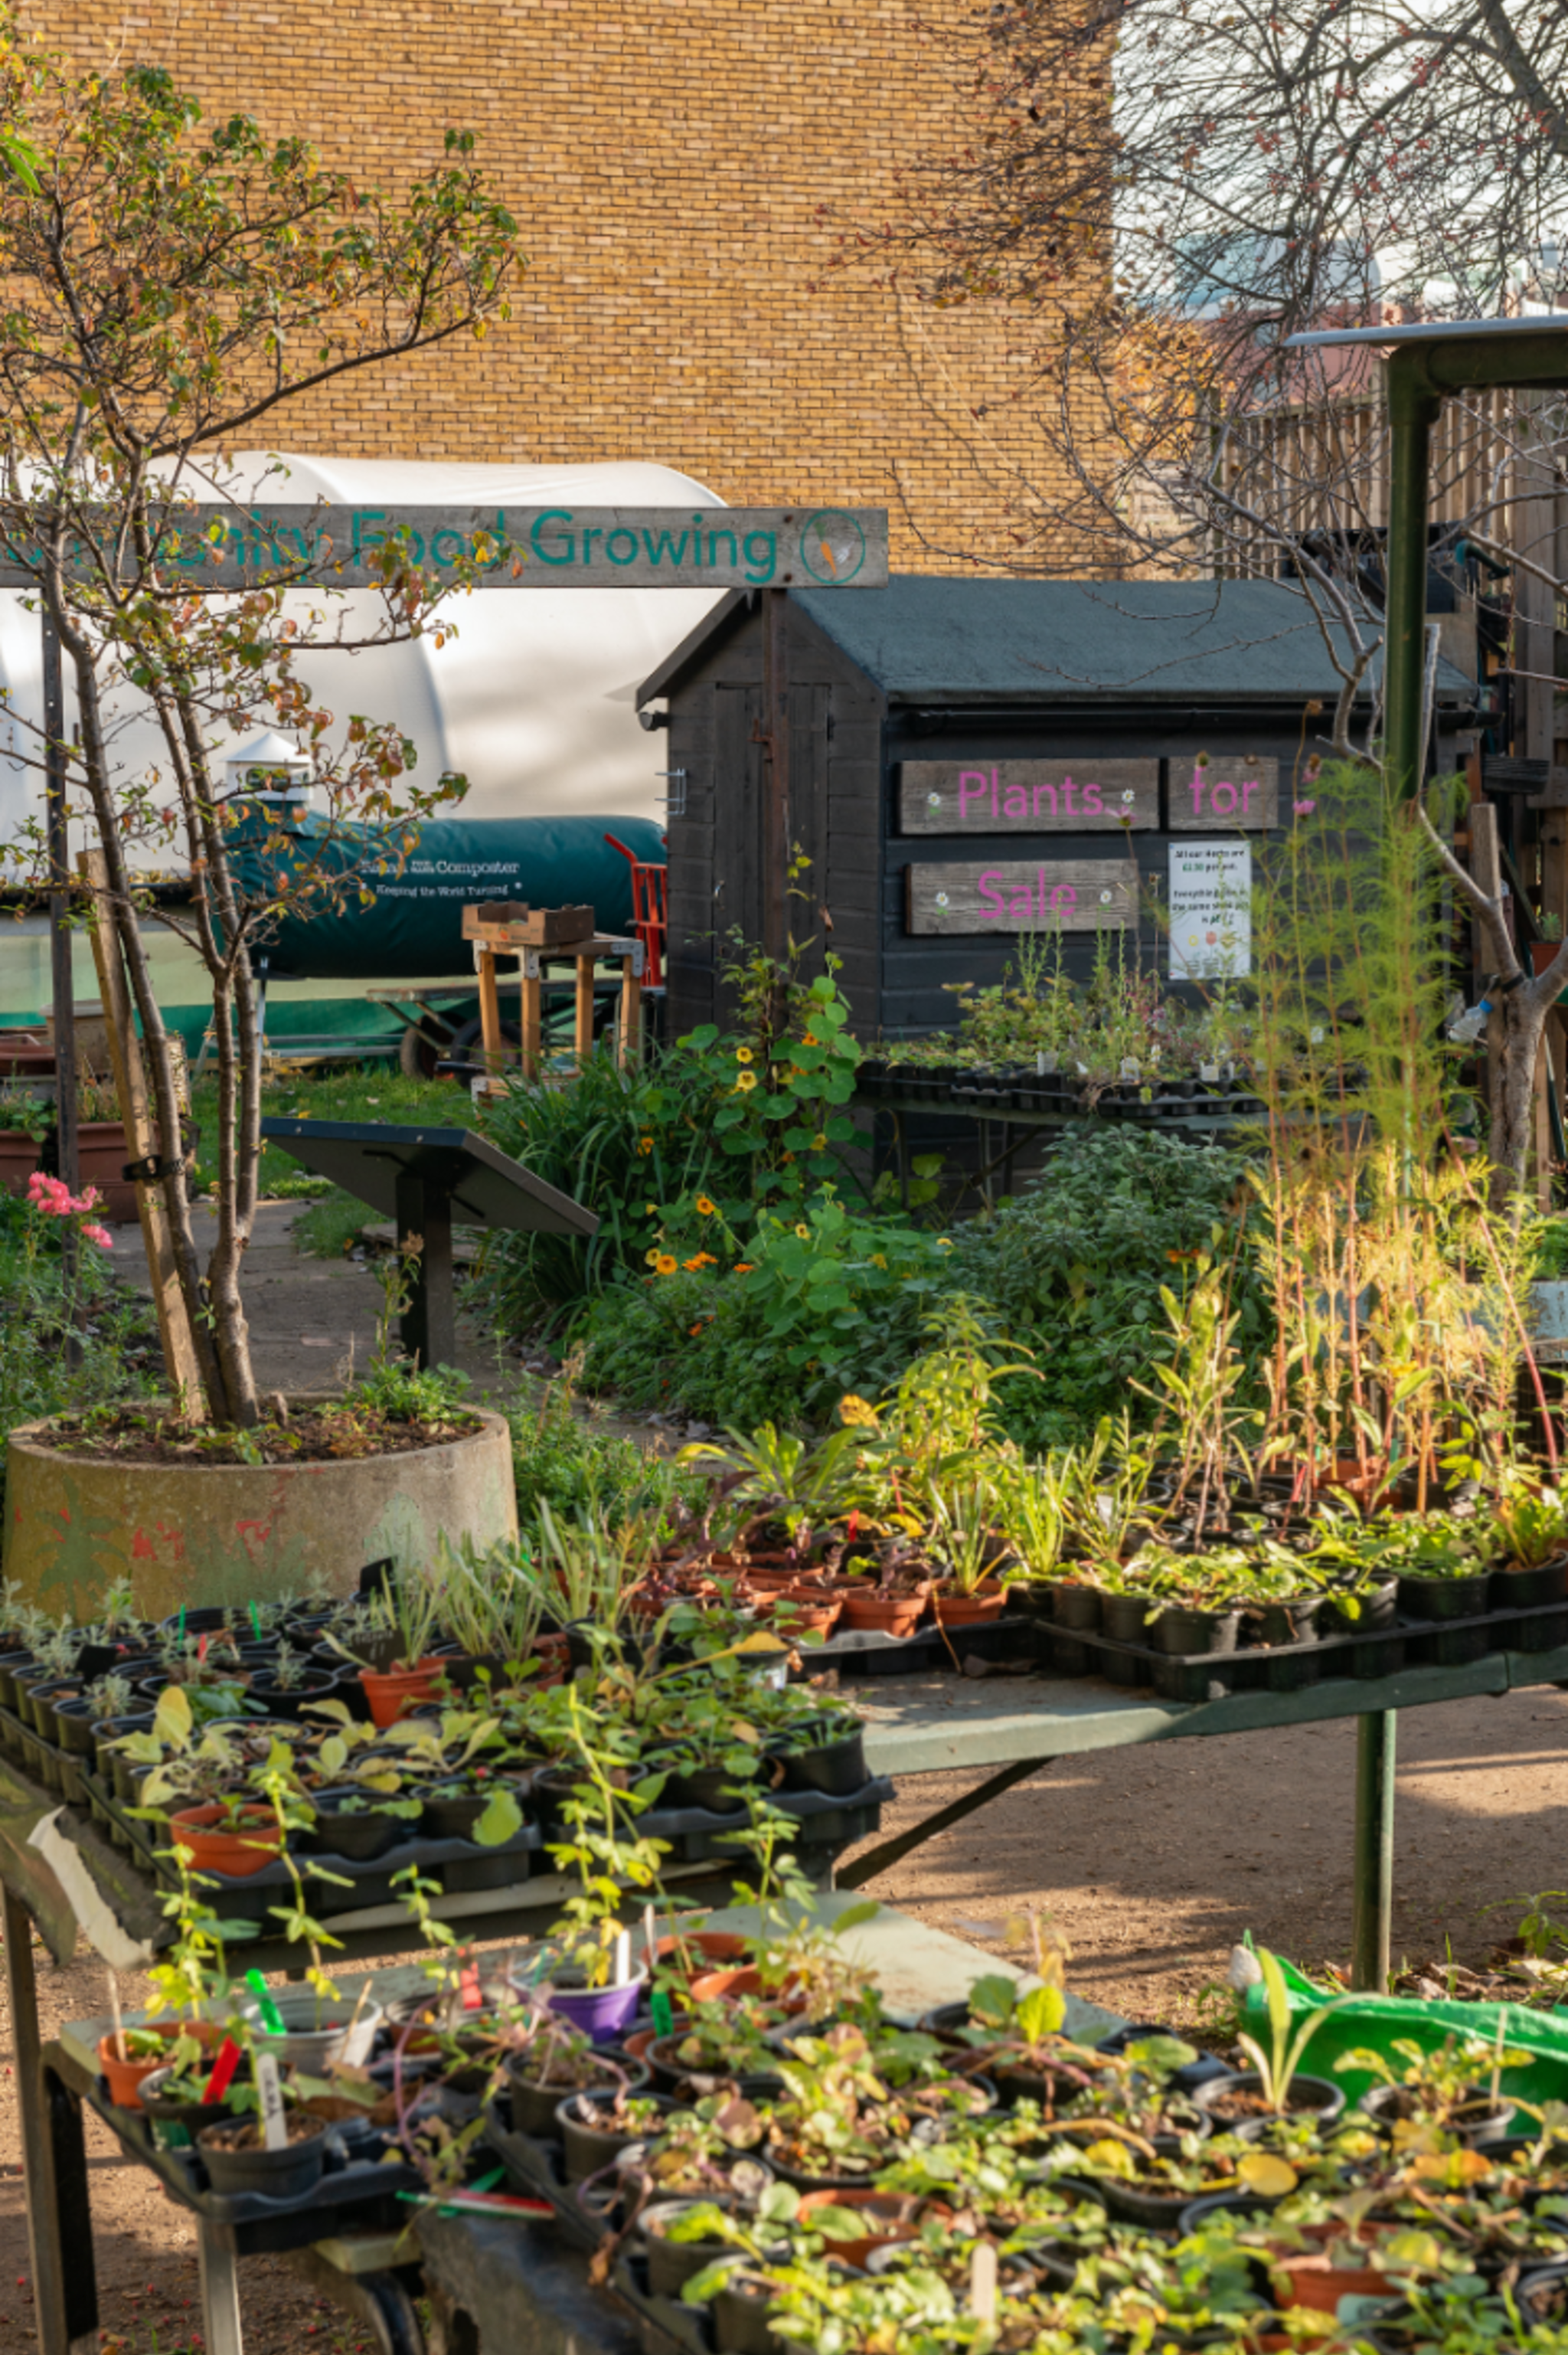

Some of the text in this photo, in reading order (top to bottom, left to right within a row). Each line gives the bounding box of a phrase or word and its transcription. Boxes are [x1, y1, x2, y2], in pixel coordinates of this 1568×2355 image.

[531, 509, 777, 584] Growing
[959, 768, 1104, 817] Plants
[1187, 765, 1259, 814] for
[376, 884, 508, 898] Keeping the World Turning
[436, 860, 520, 876] Composter
[978, 868, 1078, 918] Sale
